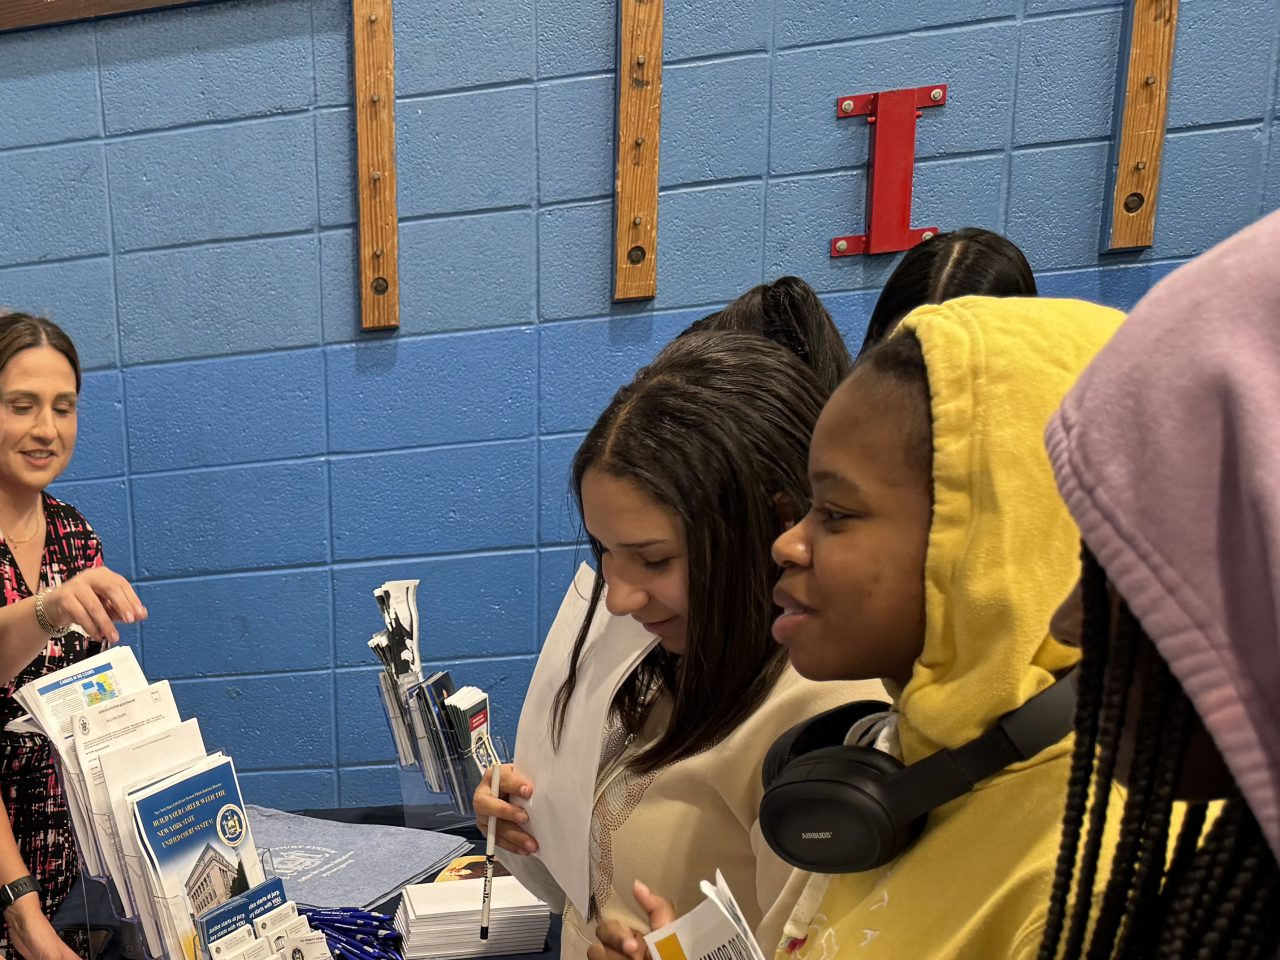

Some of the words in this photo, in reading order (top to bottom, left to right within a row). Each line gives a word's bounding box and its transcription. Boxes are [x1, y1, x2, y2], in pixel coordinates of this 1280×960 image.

[152, 815, 170, 826] BUILD
[168, 810, 182, 818] YOUR
[181, 801, 201, 813] CAREER
[200, 795, 215, 804] WITH
[215, 790, 225, 798] THE
[157, 828, 169, 836] NEW
[168, 822, 183, 831] YORK
[181, 815, 195, 824] STATE
